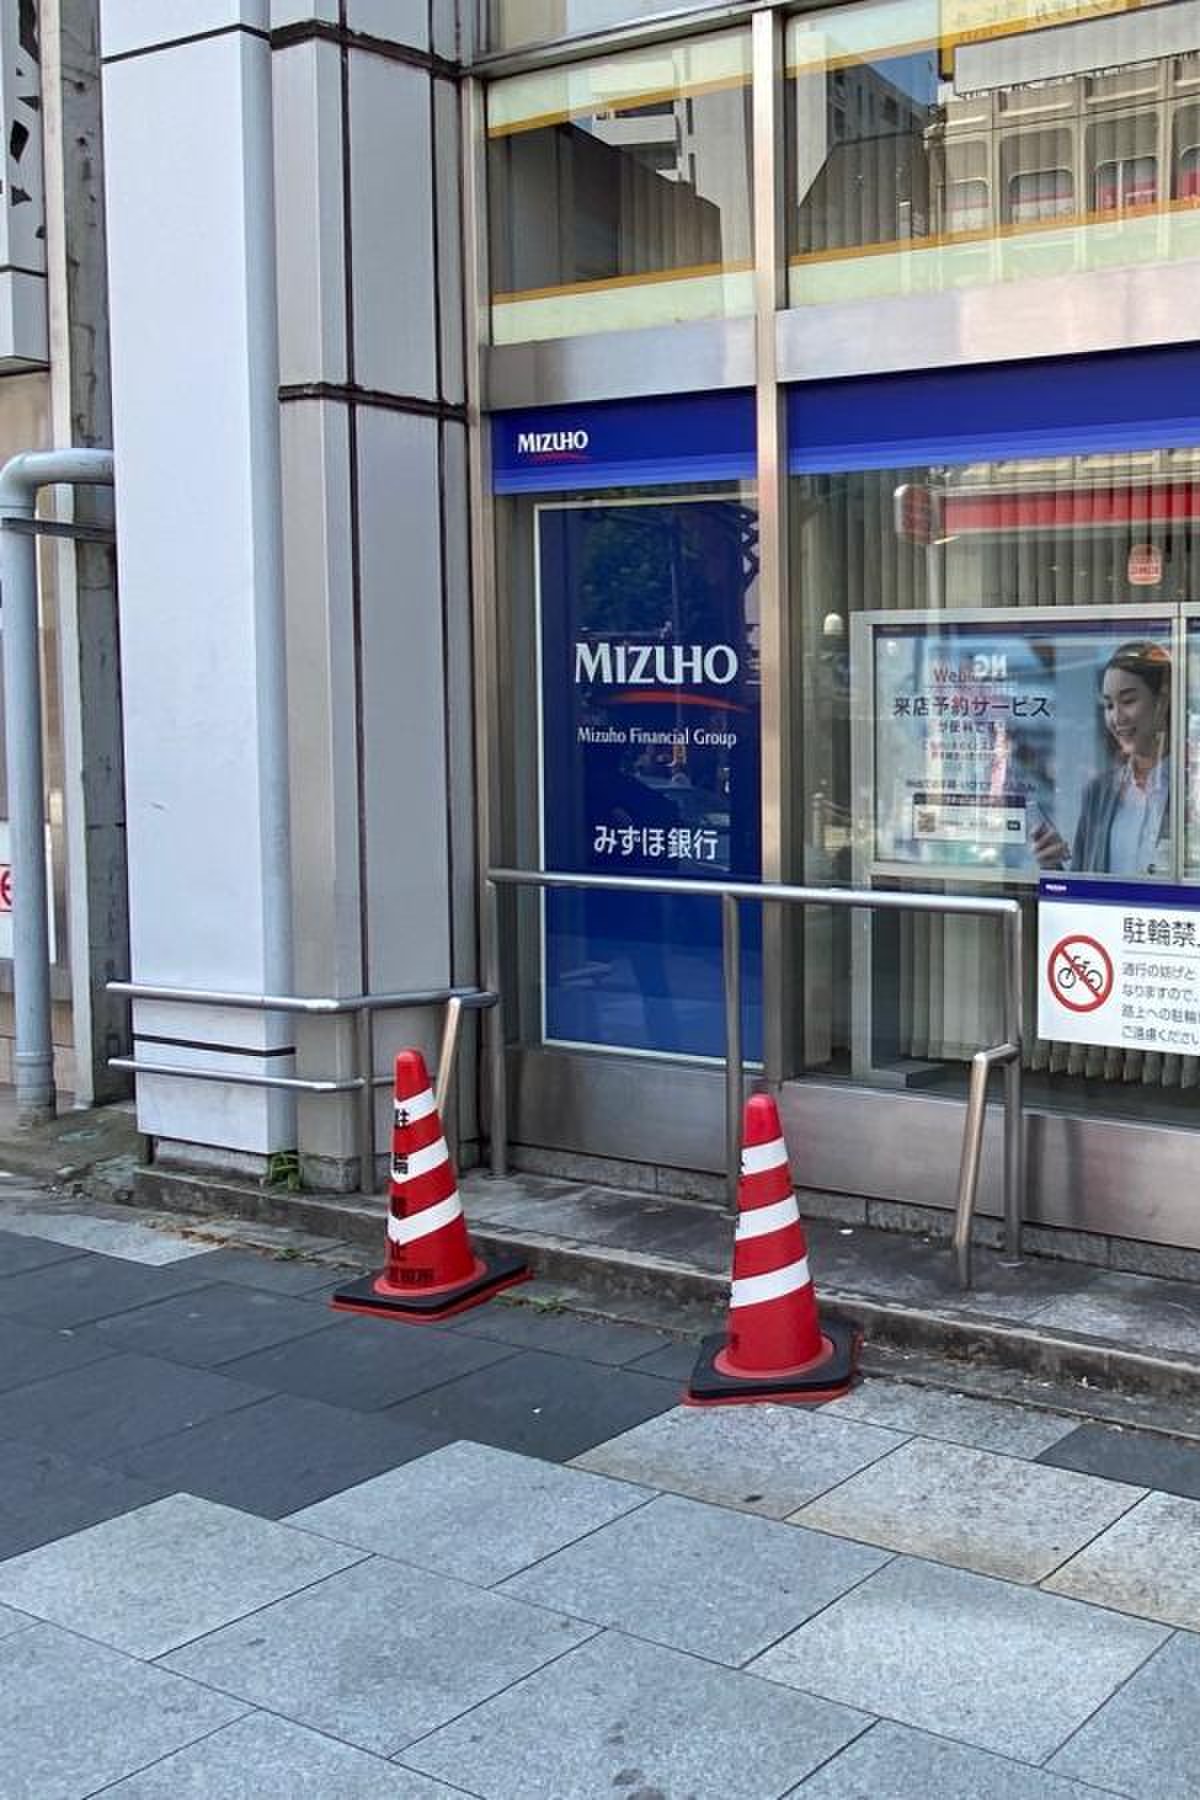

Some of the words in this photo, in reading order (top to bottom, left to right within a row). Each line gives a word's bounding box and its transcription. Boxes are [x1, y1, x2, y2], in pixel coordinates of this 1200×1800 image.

[518, 431, 589, 453] MIZUHO
[575, 643, 739, 684] MIZUHO
[893, 696, 1051, 718] 来店予約サービス
[577, 727, 626, 744] Mizuho
[630, 727, 689, 745] Financial
[693, 729, 737, 748] Group
[593, 824, 718, 861] みずほ銀行
